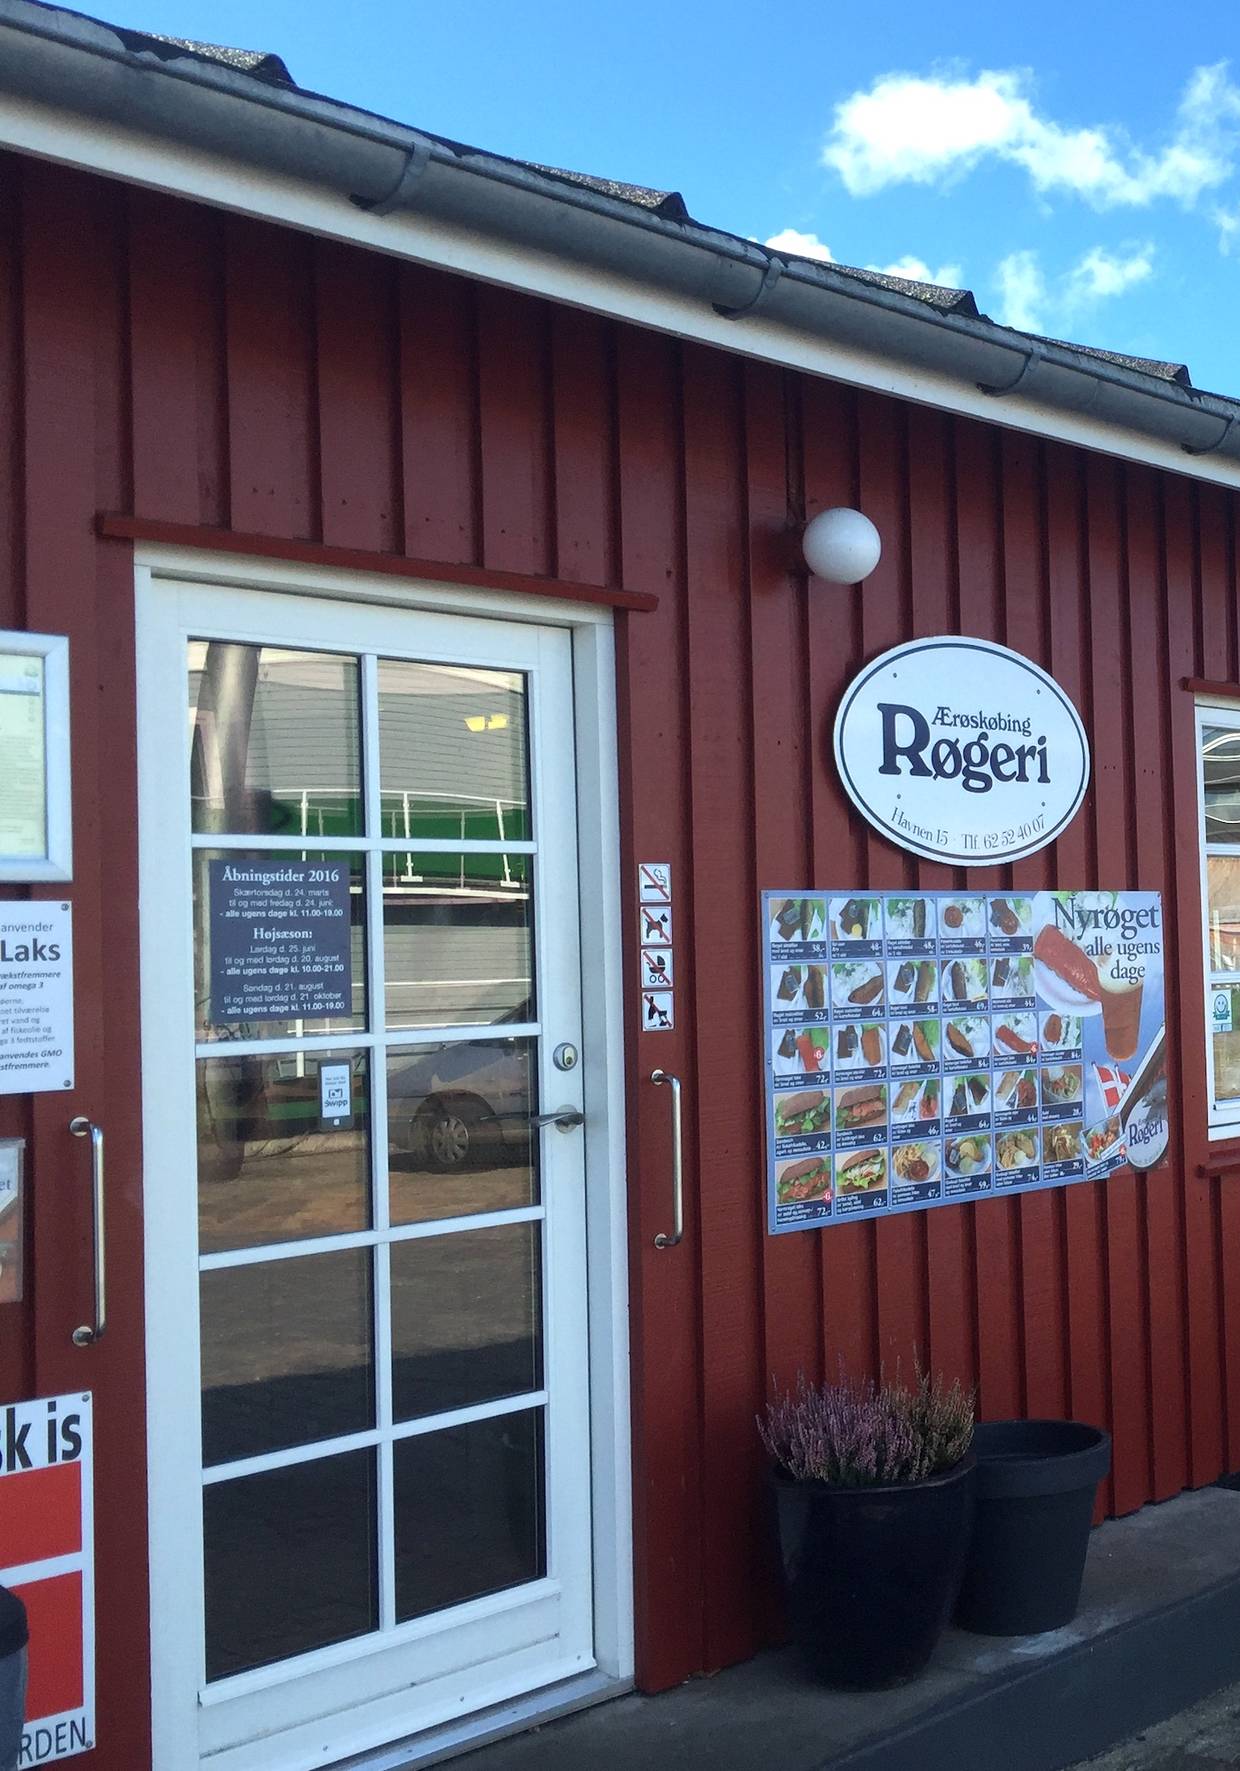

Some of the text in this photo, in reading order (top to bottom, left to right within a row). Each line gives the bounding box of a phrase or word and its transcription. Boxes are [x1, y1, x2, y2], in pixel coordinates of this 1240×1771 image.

[931, 706, 1031, 737] Ærøskøbing
[877, 702, 1051, 793] Røgeri
[891, 806, 1046, 850] Havnen 15 Tlf. 62 52 40 07
[222, 865, 339, 885] Åbningstider 2016
[308, 888, 329, 896] marts
[228, 899, 236, 907] til
[238, 900, 248, 908] og
[250, 899, 268, 907] med
[269, 899, 294, 908] fredag
[225, 909, 240, 917] alle
[241, 911, 266, 919] ugens
[267, 910, 288, 919] dage
[289, 909, 298, 917] kl.
[301, 908, 343, 917] 11.00-19.00
[1053, 897, 1160, 941] Nyrøget
[253, 927, 313, 943] Højsæson:
[0, 938, 61, 962] Laks
[249, 945, 277, 954] Lørdag
[1085, 935, 1160, 962] alle ugens
[224, 957, 232, 965] til
[234, 957, 244, 966] og
[246, 956, 264, 964] med
[265, 955, 289, 965] lørdag
[314, 954, 339, 963] august
[226, 967, 241, 975] alle
[242, 967, 267, 976] ugens
[268, 966, 288, 975] dage
[290, 965, 299, 973] kl.
[302, 964, 344, 973] 10.00-21.00
[1110, 960, 1145, 985] dage
[8, 983, 36, 991] omega
[243, 984, 273, 993] Søndag
[298, 983, 324, 992] august
[233, 996, 243, 1005] og
[245, 995, 262, 1003] med
[313, 992, 342, 1000] oktober
[226, 1006, 241, 1014] alle
[243, 1006, 268, 1015] ugens
[269, 1005, 289, 1013] dage
[302, 1001, 345, 1010] 11.00-19.00
[41, 1049, 62, 1058] GMO
[324, 1099, 348, 1107] Swipp
[47, 1401, 82, 1464] is
